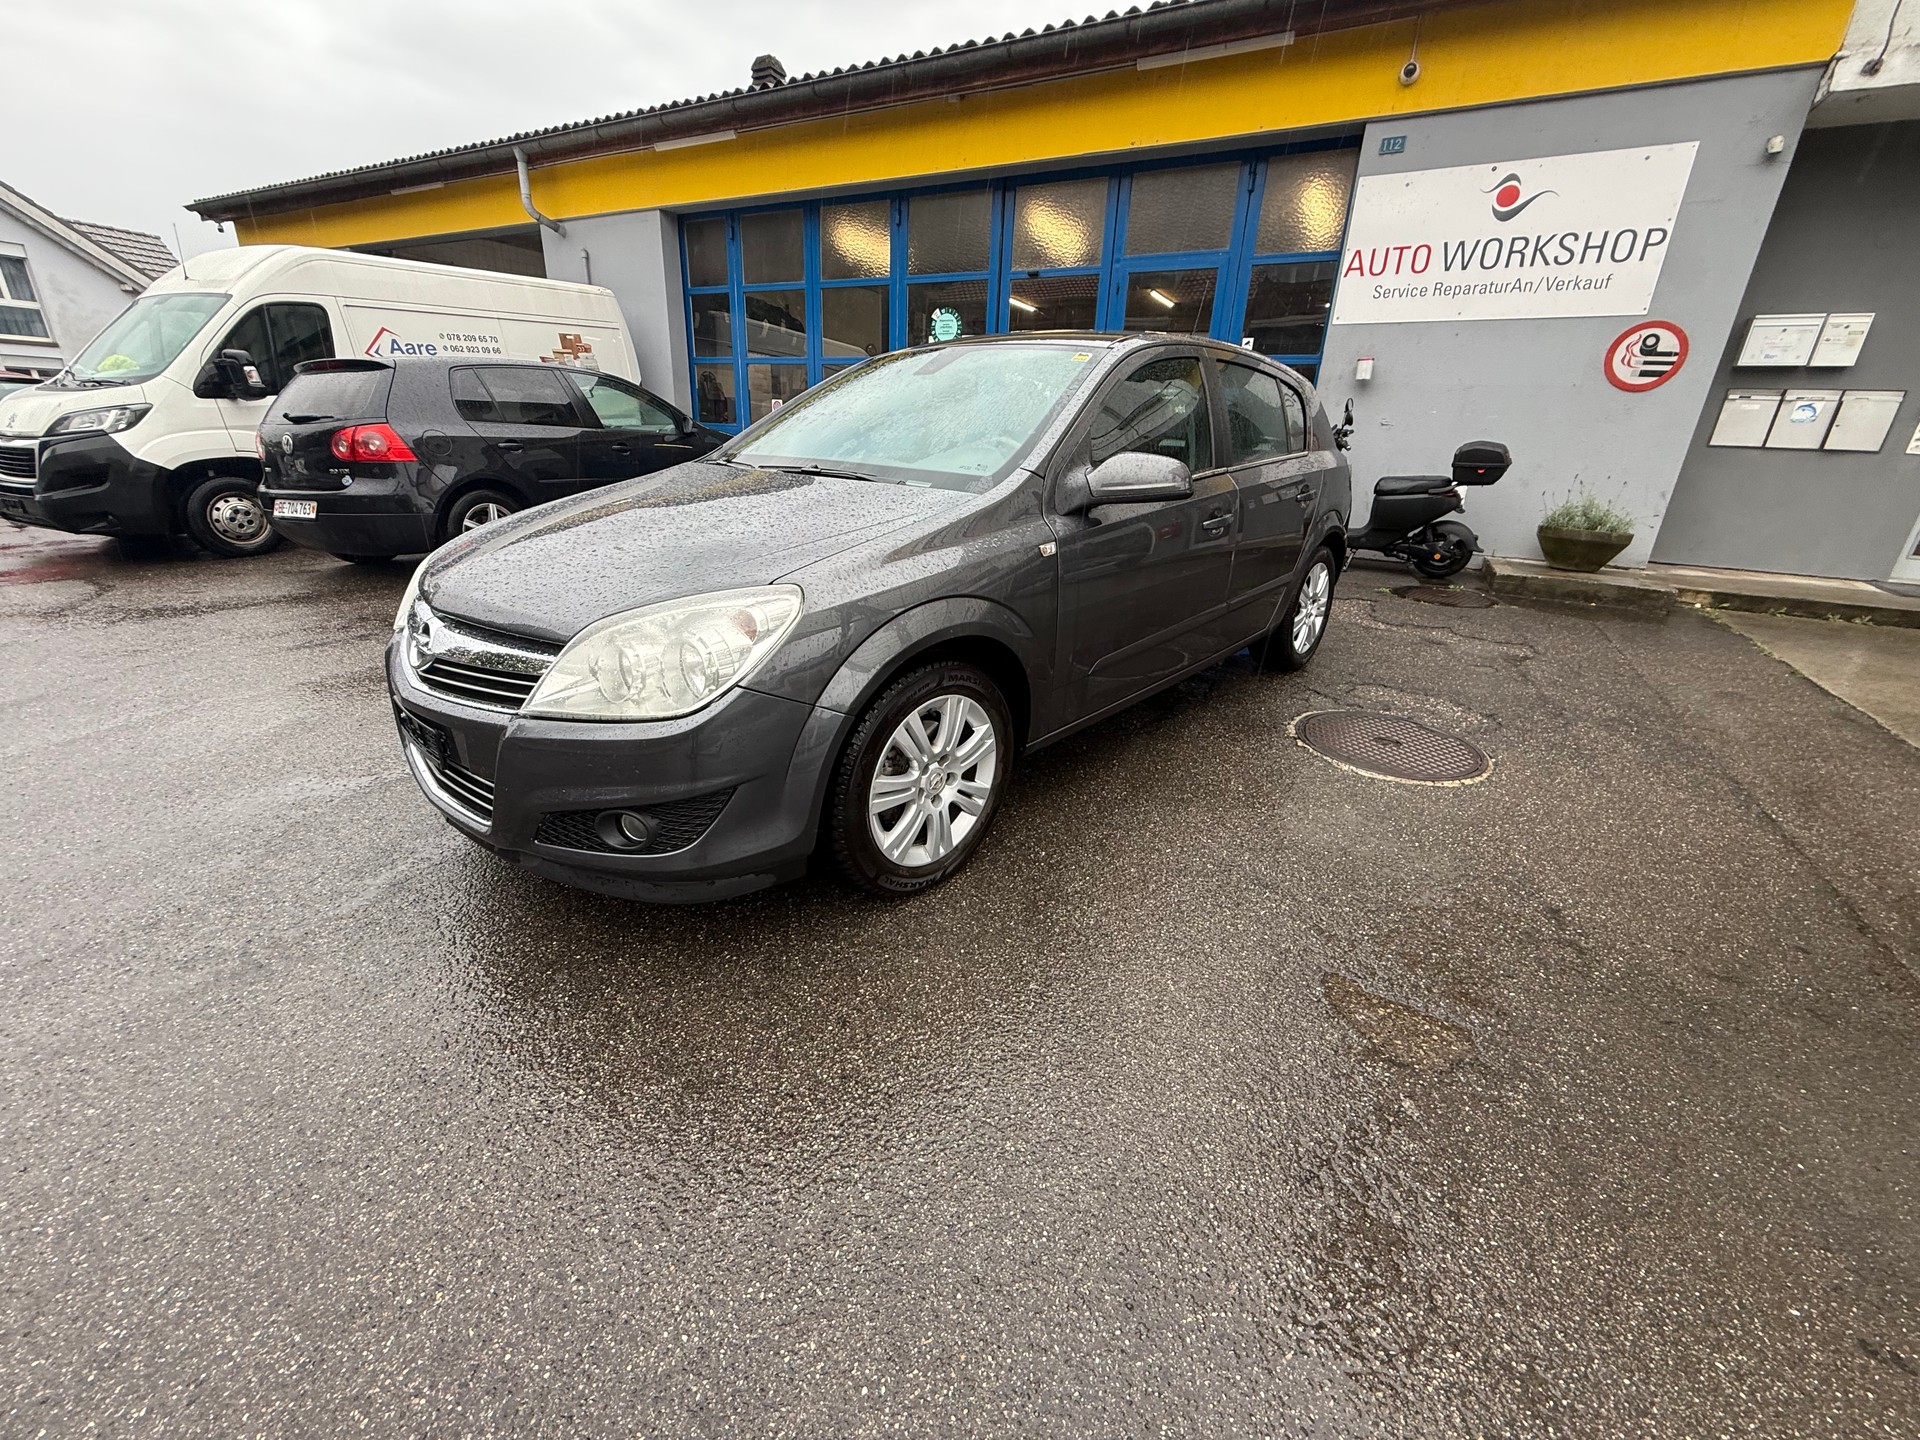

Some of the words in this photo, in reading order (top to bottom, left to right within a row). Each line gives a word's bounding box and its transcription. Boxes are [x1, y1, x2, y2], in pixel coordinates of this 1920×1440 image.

[1383, 138, 1402, 151] 112
[1343, 244, 1432, 278] AUTO
[1442, 227, 1668, 272] WORKSHOP
[1372, 282, 1428, 300] Service
[1433, 273, 1613, 299] ReparaturAn/Verkauf
[446, 333, 461, 341] 078
[463, 334, 477, 342] 209
[478, 335, 488, 343] 65
[390, 338, 438, 356] Aare
[450, 345, 465, 353] 062
[466, 345, 480, 353] 923
[481, 346, 491, 354] 09
